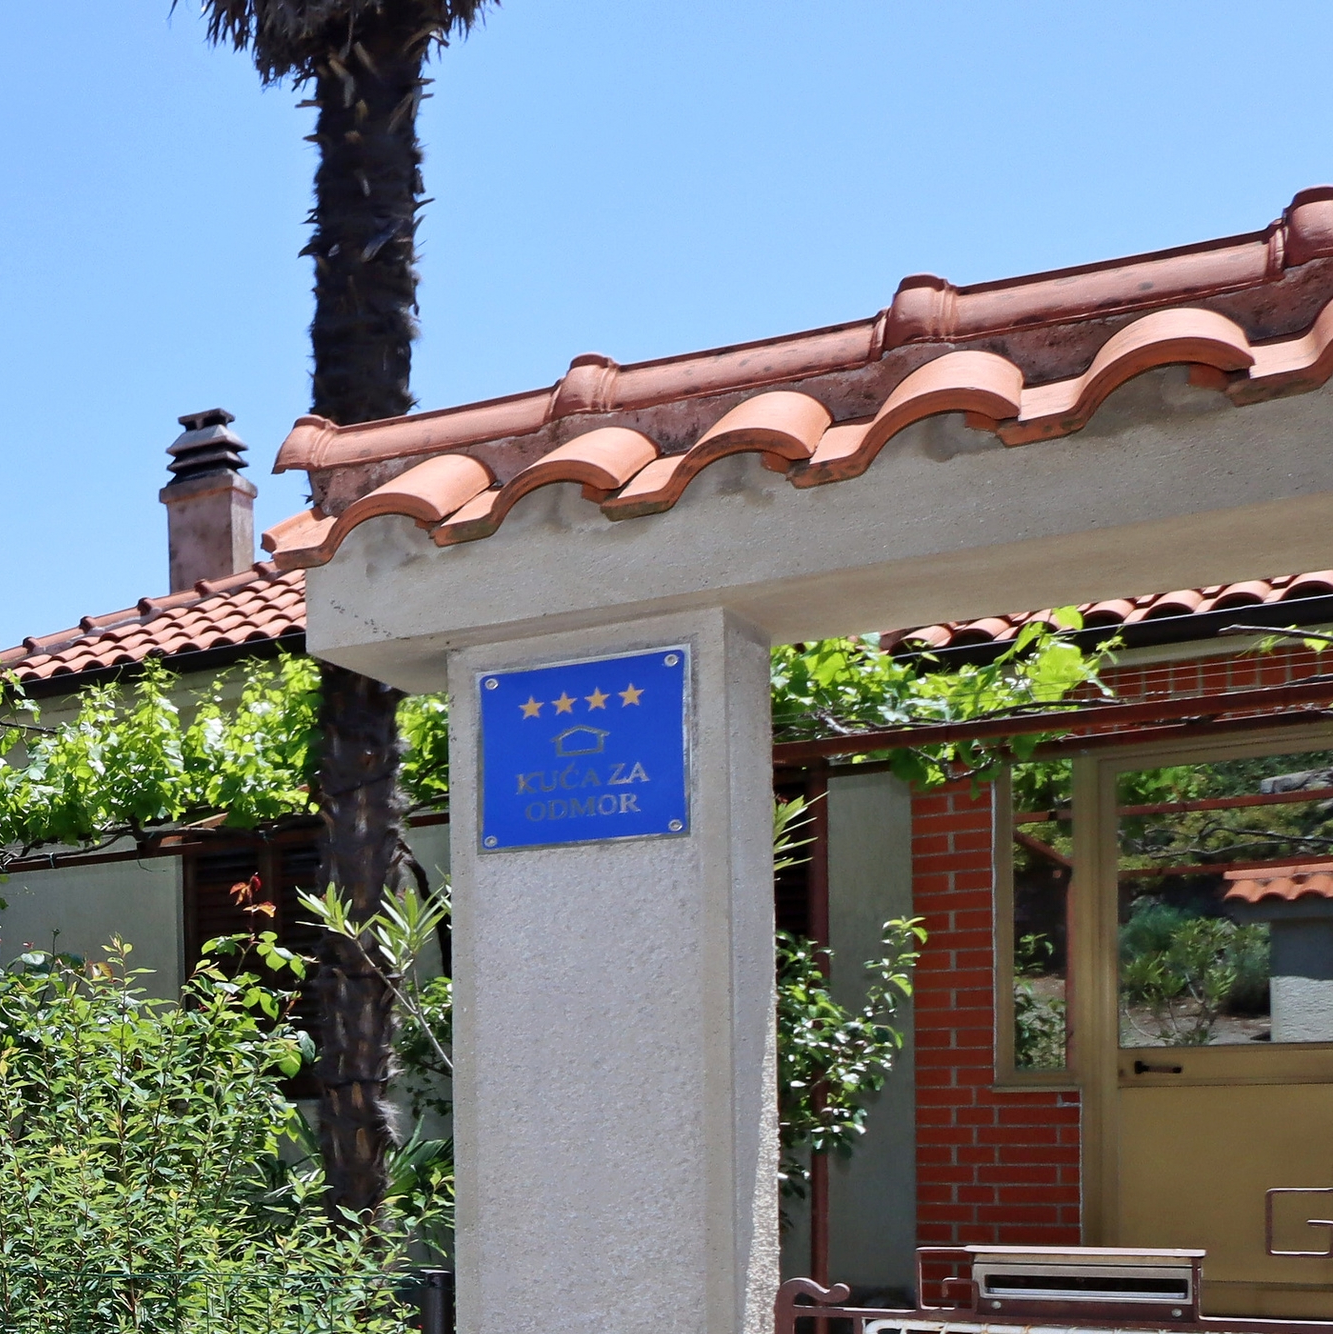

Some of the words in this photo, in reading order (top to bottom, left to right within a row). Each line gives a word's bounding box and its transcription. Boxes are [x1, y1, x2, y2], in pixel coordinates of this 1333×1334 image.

[515, 762, 601, 795] KUĆA
[607, 761, 650, 785] ZA
[525, 793, 641, 821] ODMOR
